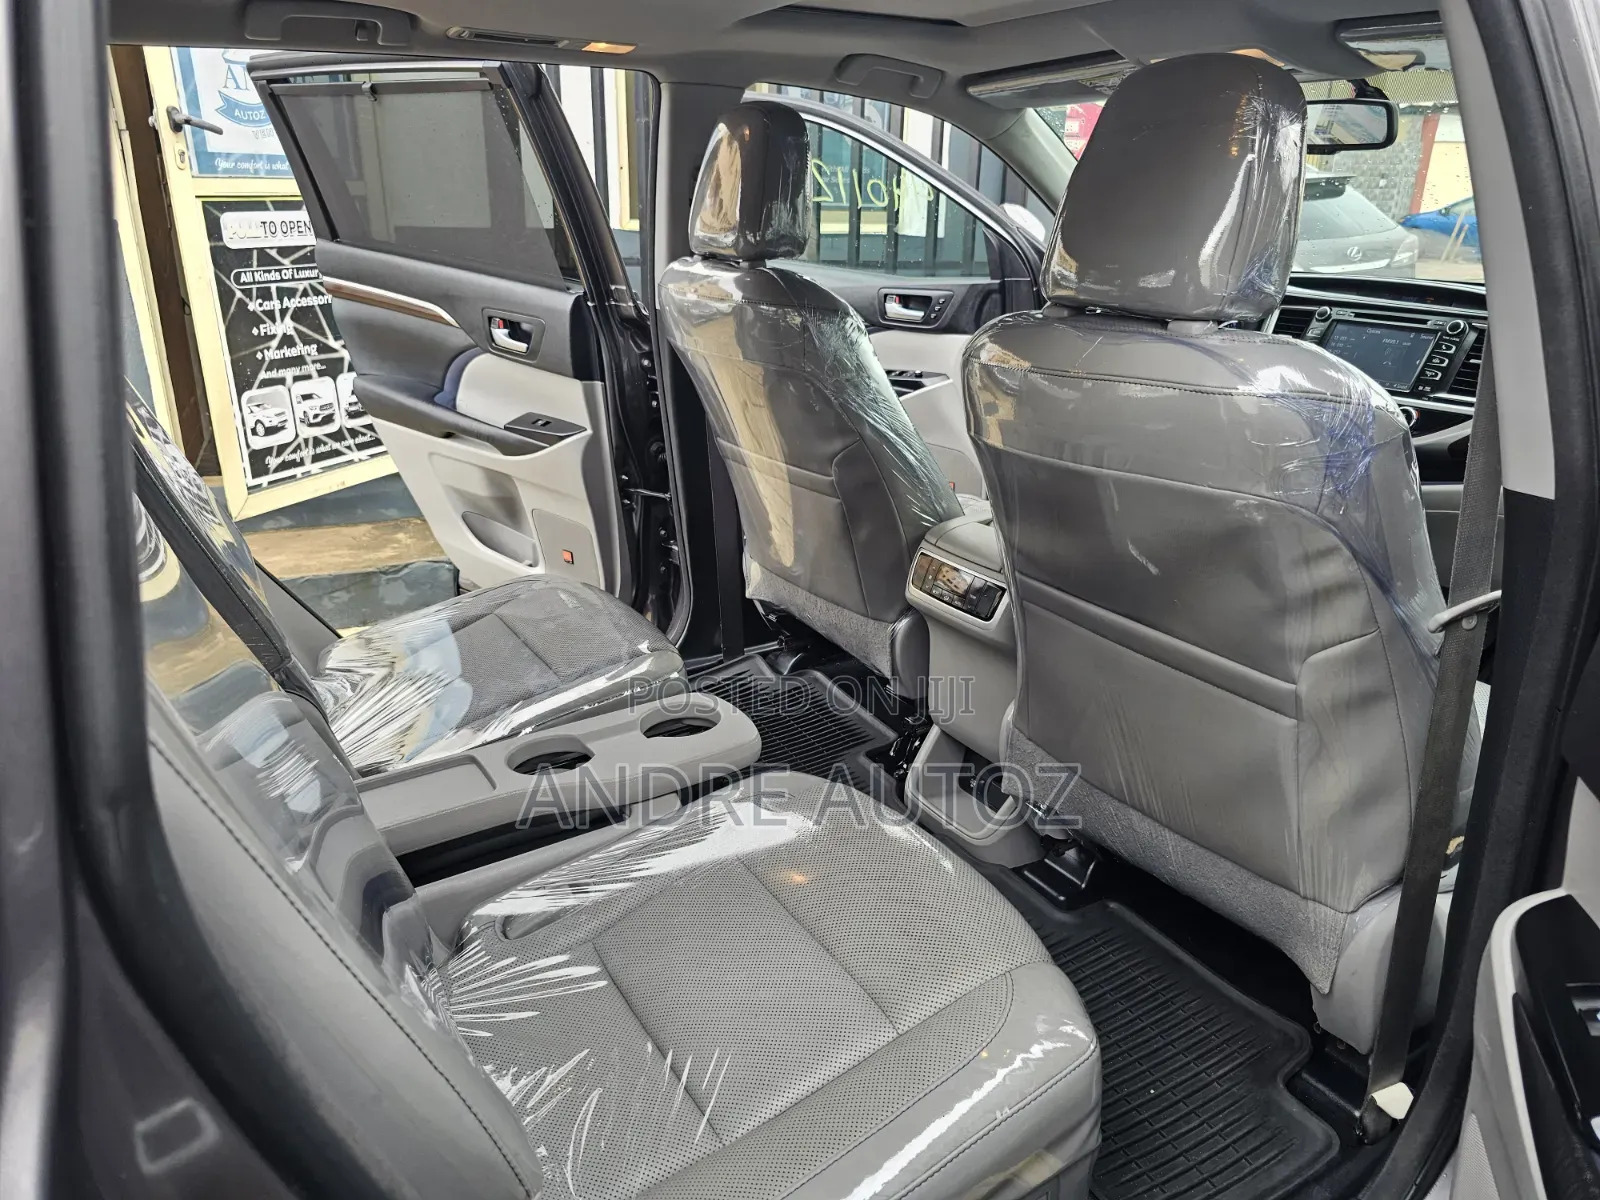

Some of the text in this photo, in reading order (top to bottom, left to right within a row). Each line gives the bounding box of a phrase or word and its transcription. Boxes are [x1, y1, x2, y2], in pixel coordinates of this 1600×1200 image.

[234, 108, 266, 121] AUTOZ
[260, 221, 277, 236] TO
[280, 220, 312, 236] OPEN
[240, 271, 253, 283] All
[254, 269, 280, 281] Kinds
[281, 268, 293, 280] Of
[255, 298, 281, 311] Cars
[259, 321, 294, 337] Fixing
[263, 344, 318, 361] Marketing
[261, 368, 278, 380] And
